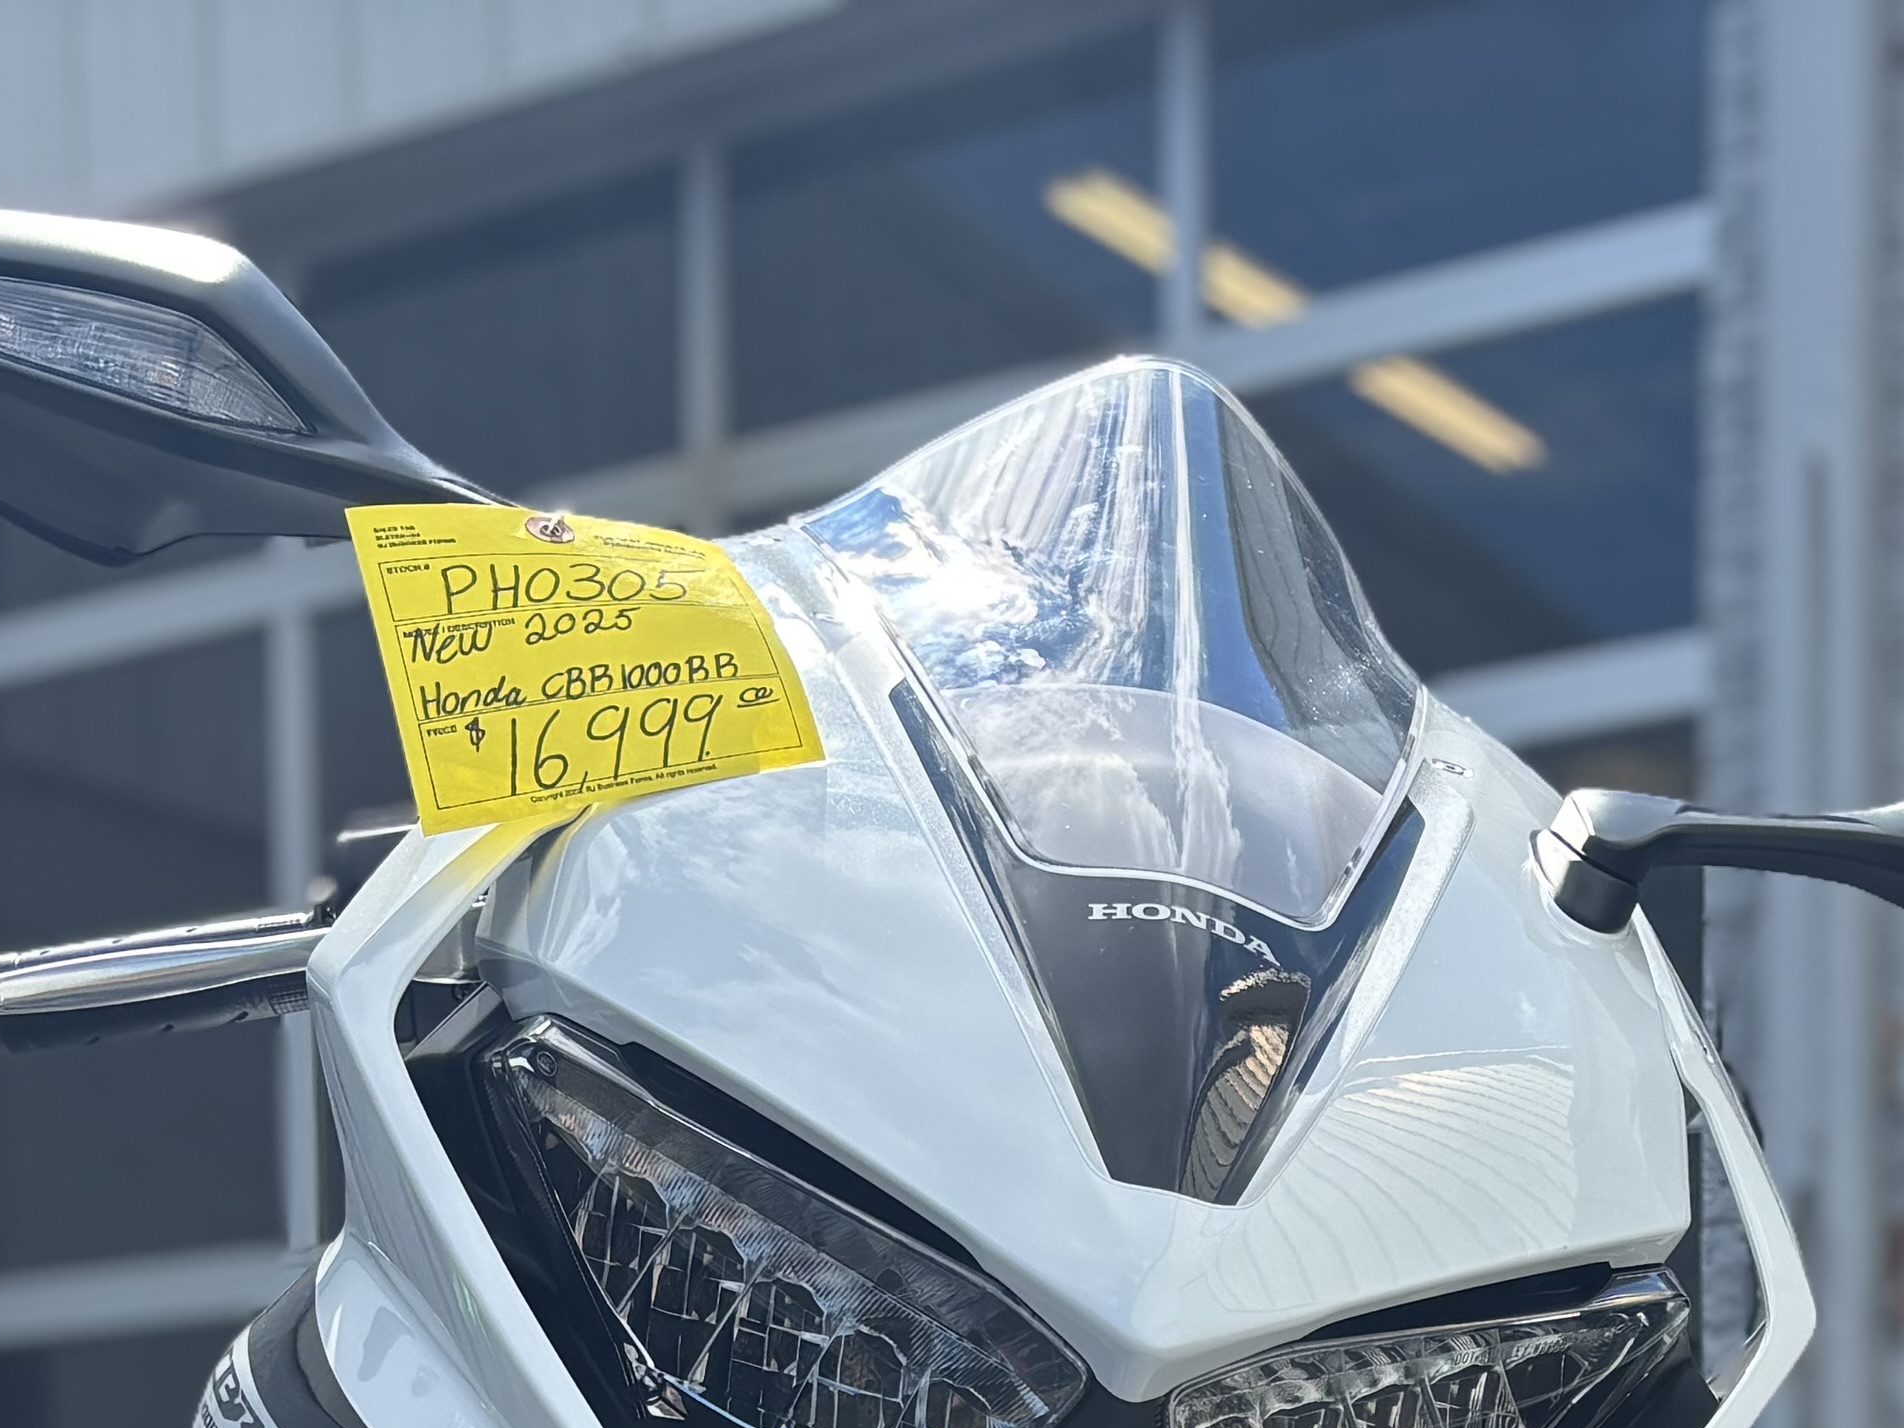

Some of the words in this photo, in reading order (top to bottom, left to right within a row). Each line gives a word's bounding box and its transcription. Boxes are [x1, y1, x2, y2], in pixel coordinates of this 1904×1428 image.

[412, 622, 492, 664] New
[525, 606, 641, 645] 2025
[420, 675, 527, 720] Honda
[1088, 903, 1281, 967] HONDA
